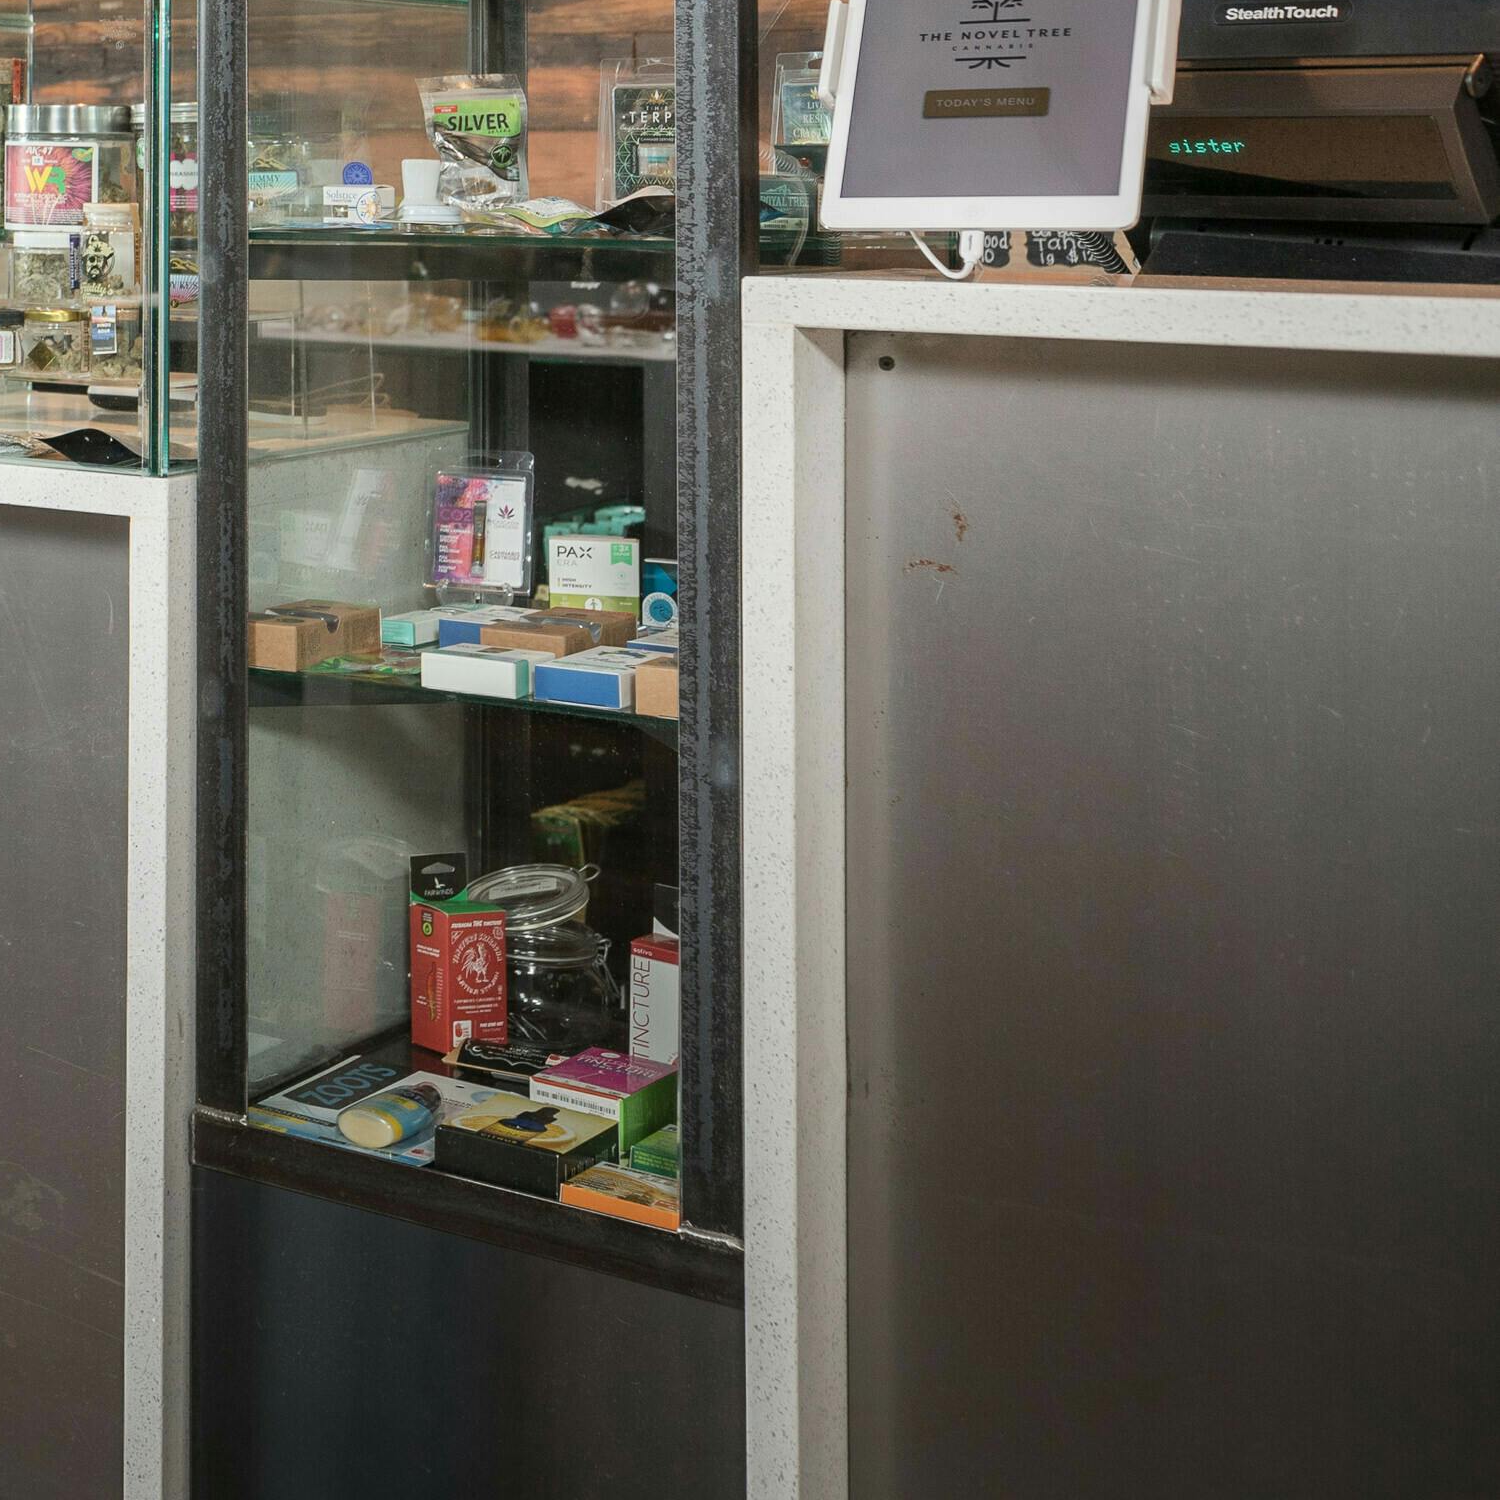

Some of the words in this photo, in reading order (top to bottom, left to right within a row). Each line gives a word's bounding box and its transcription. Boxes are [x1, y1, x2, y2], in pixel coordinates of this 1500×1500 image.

[1225, 5, 1339, 21] StealthTouch
[920, 32, 952, 42] THE
[961, 29, 1020, 40] NOVEL
[1027, 27, 1072, 38] TREE
[952, 43, 1034, 51] CANNABIS
[936, 98, 993, 108] TODAY'S
[996, 97, 1035, 107] MENU
[448, 112, 509, 132] SILVER
[629, 111, 673, 123] TERP
[326, 190, 357, 200] Solstice
[983, 231, 1009, 250] ood
[1040, 252, 1055, 265] 1g
[557, 545, 592, 559] PAX
[632, 947, 653, 957] sativa
[632, 956, 651, 1060] TINCTURE
[298, 1063, 398, 1106] ZOOTS
